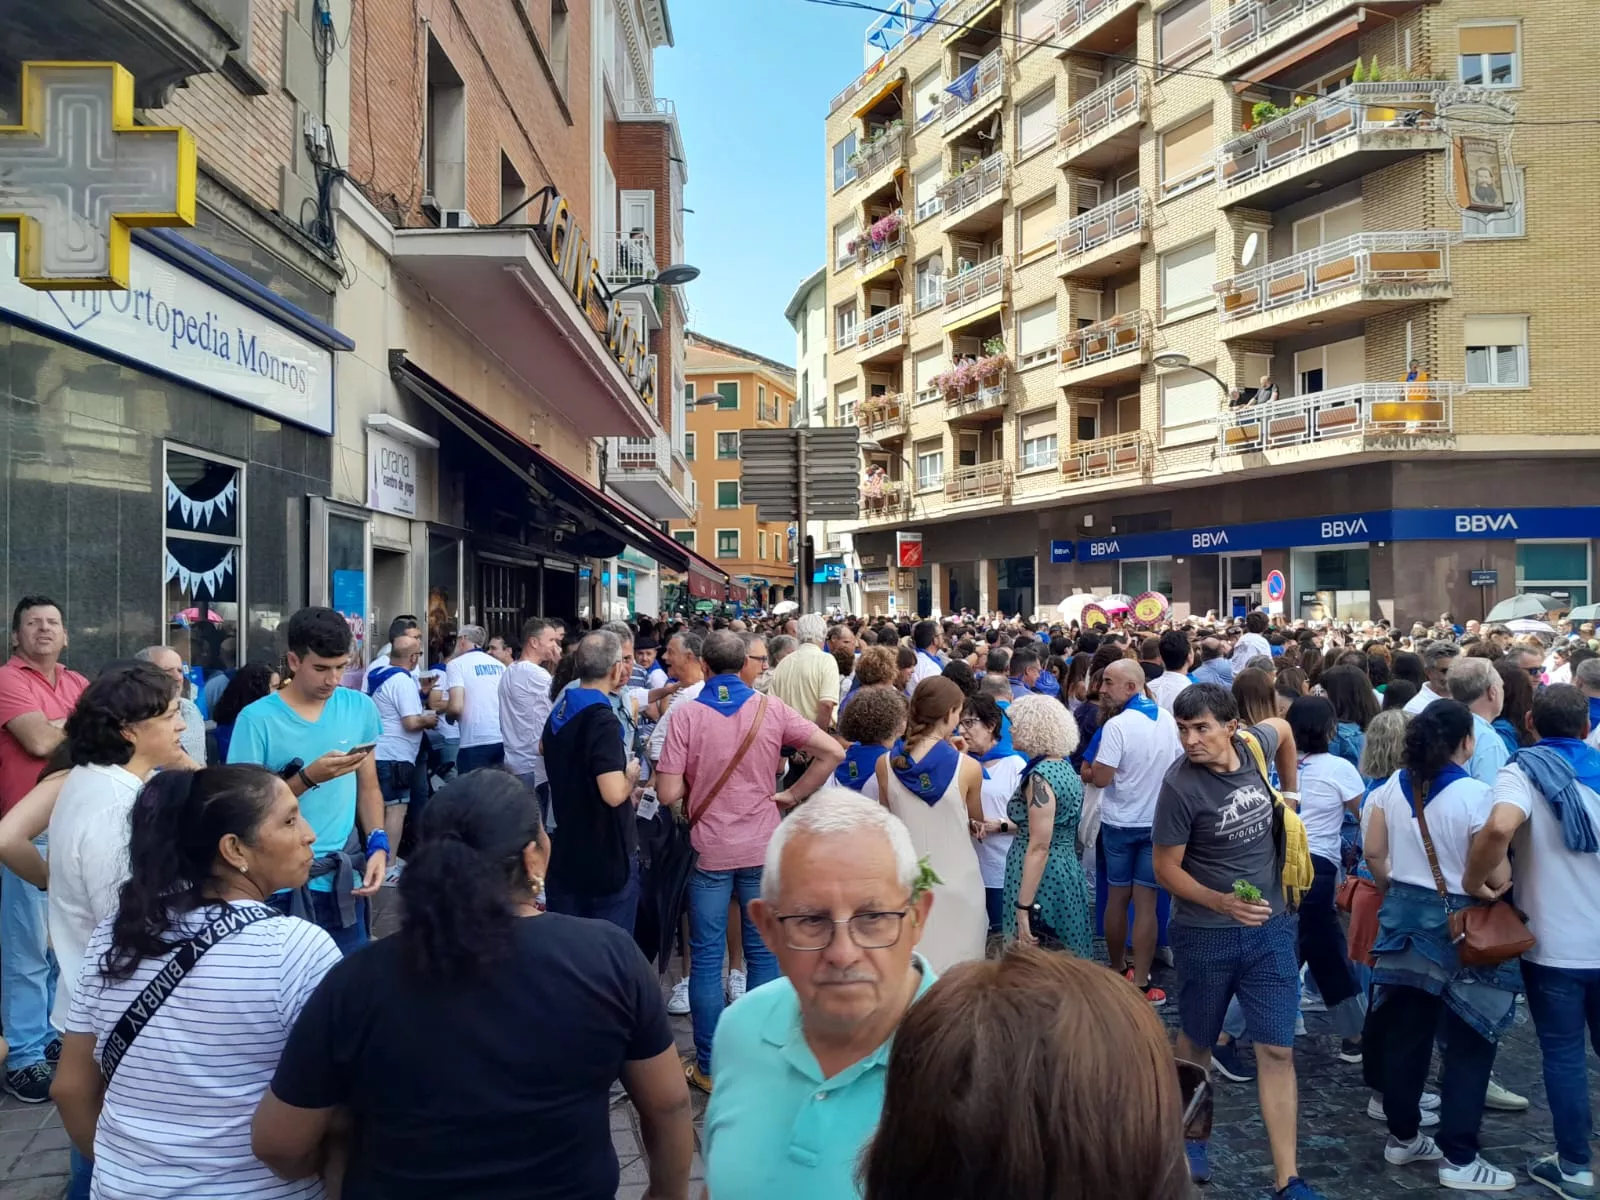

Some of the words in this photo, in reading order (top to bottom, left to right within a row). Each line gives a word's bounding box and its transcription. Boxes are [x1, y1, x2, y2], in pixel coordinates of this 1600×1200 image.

[236, 328, 307, 394] Monros
[381, 447, 410, 478] prana
[1321, 518, 1368, 538] BBVA
[1455, 512, 1519, 532] BBVA
[1090, 540, 1120, 556] BBVA
[1192, 530, 1229, 548] BBVA
[190, 906, 268, 958] BIMBAY
[130, 959, 185, 1033] BIMBAY
